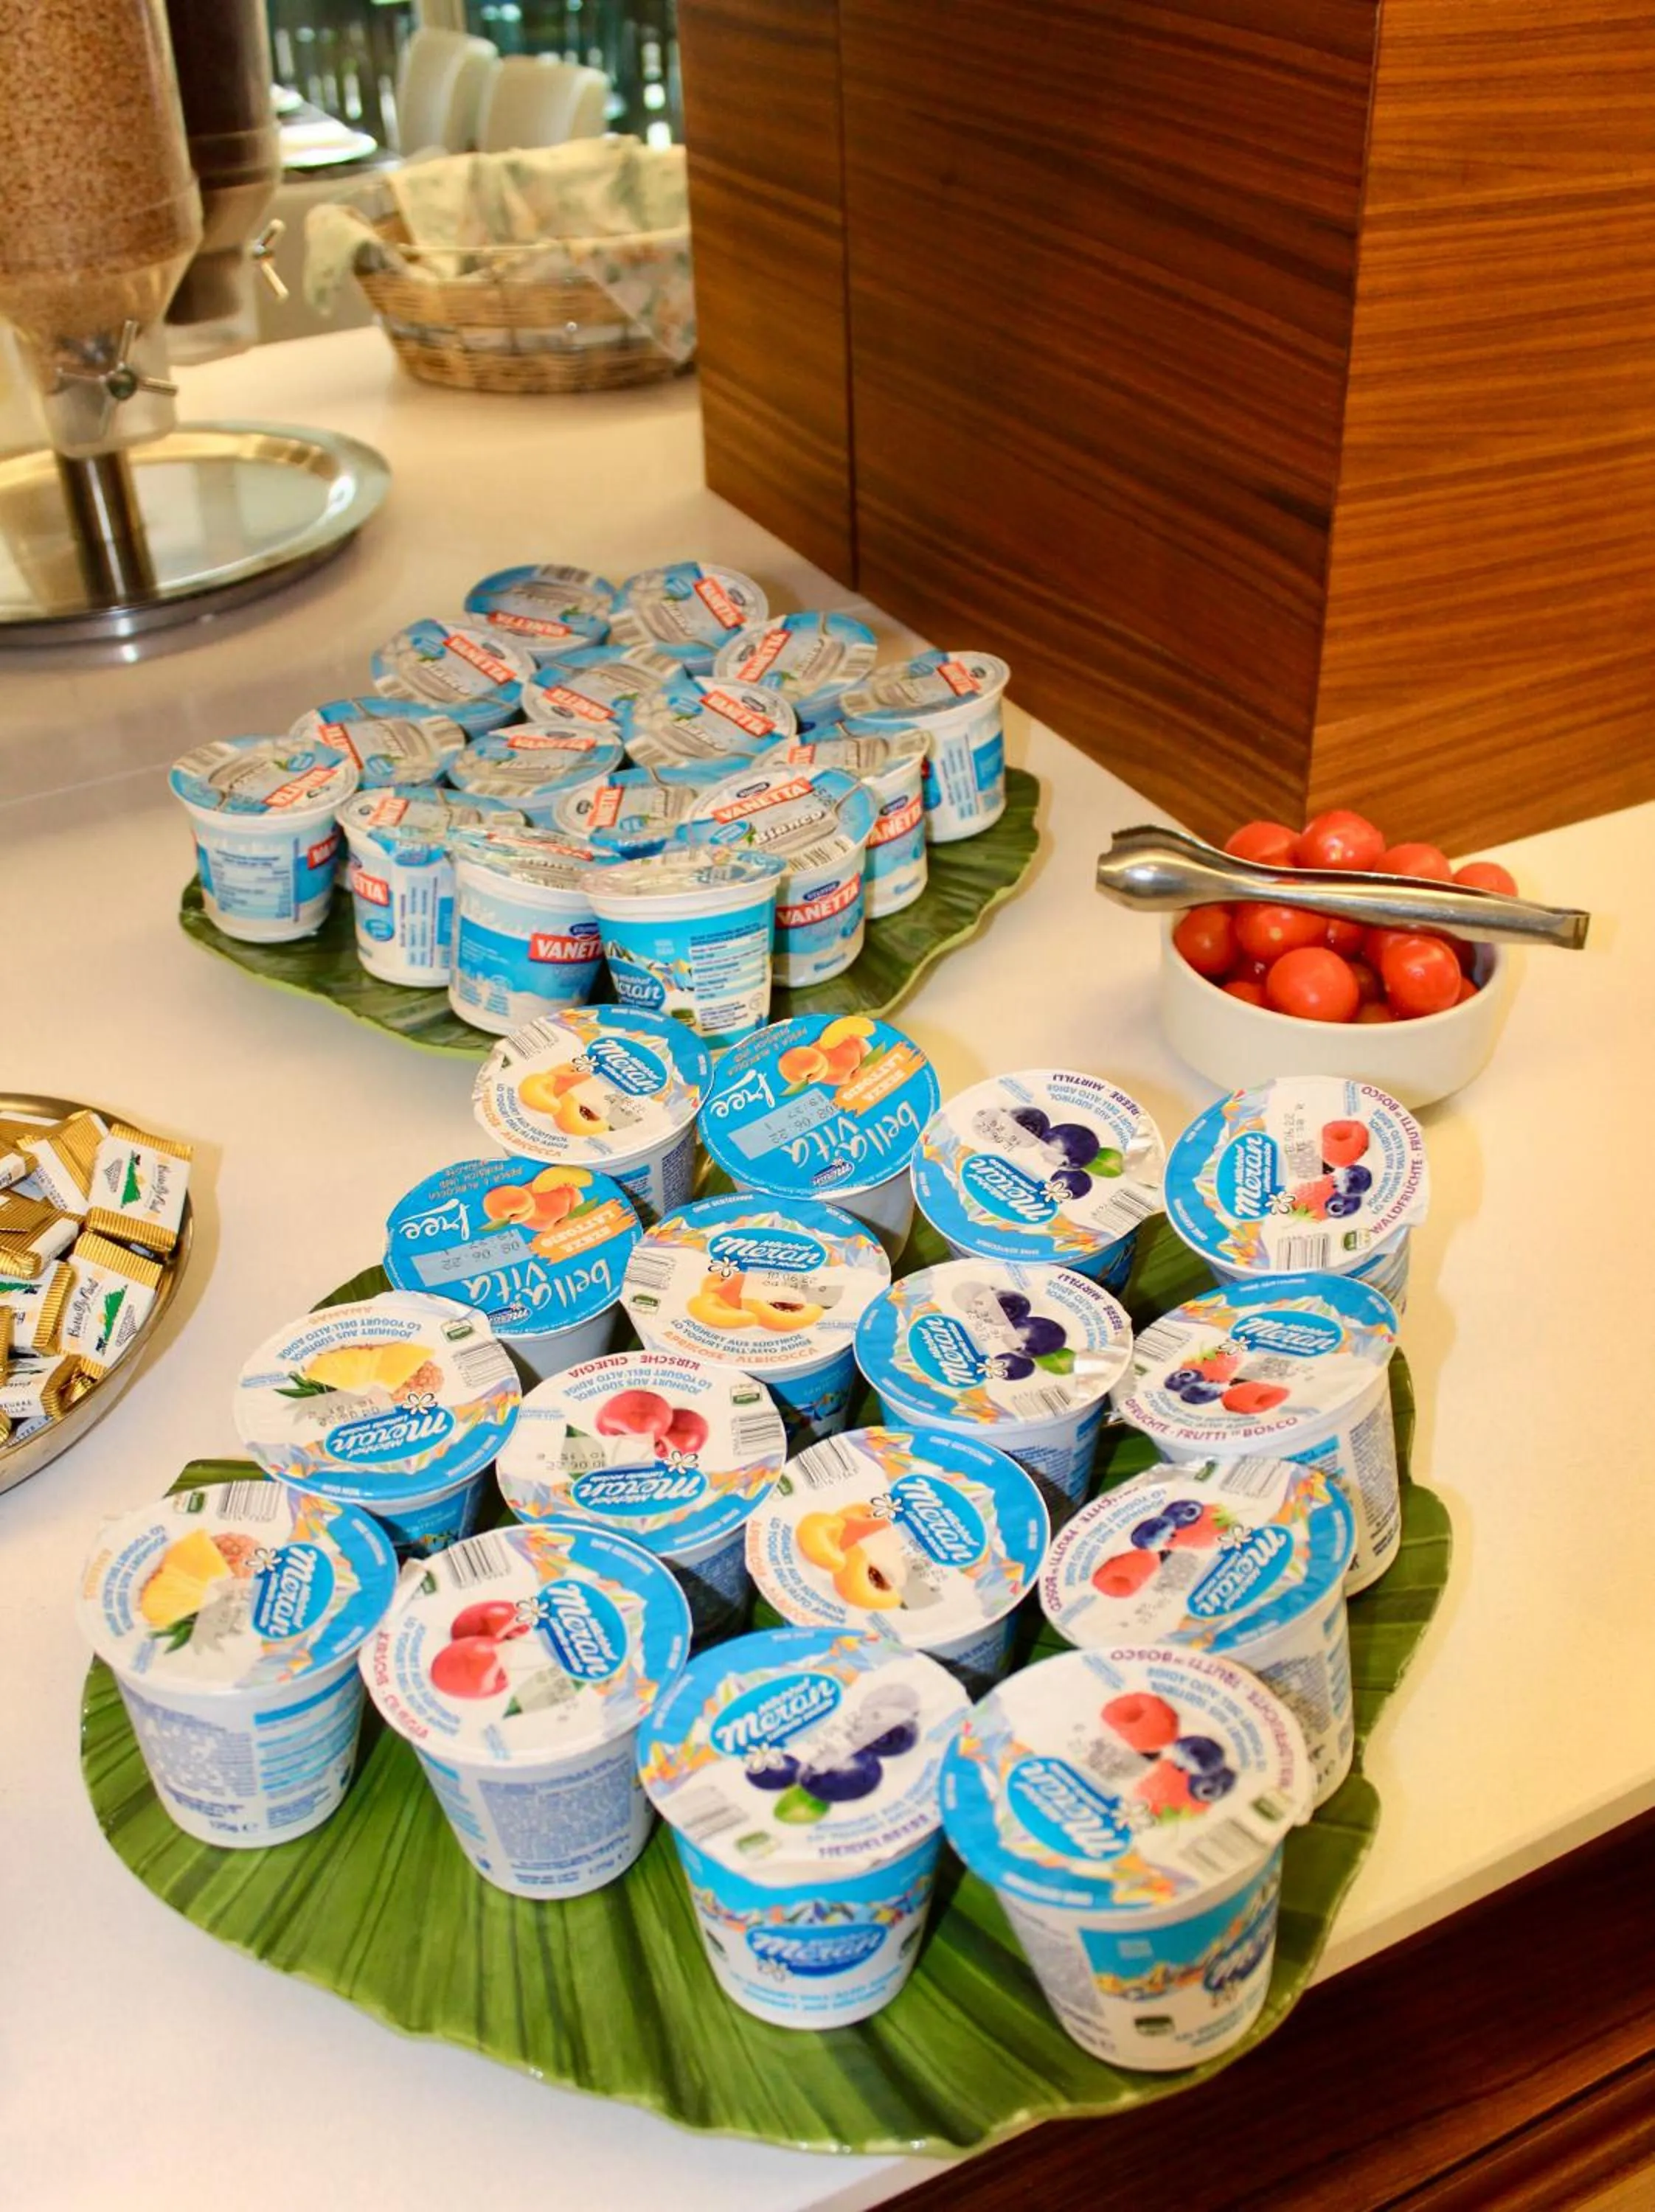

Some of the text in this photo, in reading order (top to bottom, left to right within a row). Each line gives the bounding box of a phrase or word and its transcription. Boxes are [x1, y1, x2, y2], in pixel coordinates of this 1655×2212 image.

[716, 779, 808, 821] VANETTA
[868, 801, 921, 844] ANETTA
[592, 1039, 660, 1094] Meran
[1052, 1073, 1106, 1092] MIRTILLI
[710, 1069, 776, 1119] free
[1361, 1085, 1401, 1112] BOSCO
[782, 1116, 860, 1169] vita
[839, 1100, 922, 1164] bella
[1401, 1112, 1423, 1152] FRUTTI
[970, 1158, 1054, 1221] Meran
[1235, 1135, 1265, 1217] Meran
[1369, 1158, 1424, 1235] WALDFRÜCHTE
[399, 1197, 471, 1241] free
[712, 1237, 824, 1266] Meran
[461, 1261, 548, 1306] vita
[521, 1259, 613, 1311] bella
[360, 1316, 406, 1330] YOGURT
[364, 1326, 414, 1340] JOGHURT
[1232, 1318, 1334, 1350] Meran
[568, 1354, 701, 1378] KIRSCHE CILIEGIA
[662, 1330, 818, 1364] APRIKOSE ALBICOCCA
[925, 1317, 979, 1387] Meran
[651, 1368, 696, 1386] YOGURT
[332, 1411, 449, 1454] Meran
[1176, 1416, 1299, 1441] FRUTTI BOSCO
[579, 1475, 701, 1500] Meran
[898, 1478, 974, 1562] Meran
[269, 1545, 318, 1637] Meran
[1198, 1527, 1288, 1615] Meran
[547, 1582, 609, 1676] Meran
[1110, 1649, 1173, 1664] BOSCO
[715, 1678, 837, 1753] Meran
[1018, 1761, 1127, 1859] Meran
